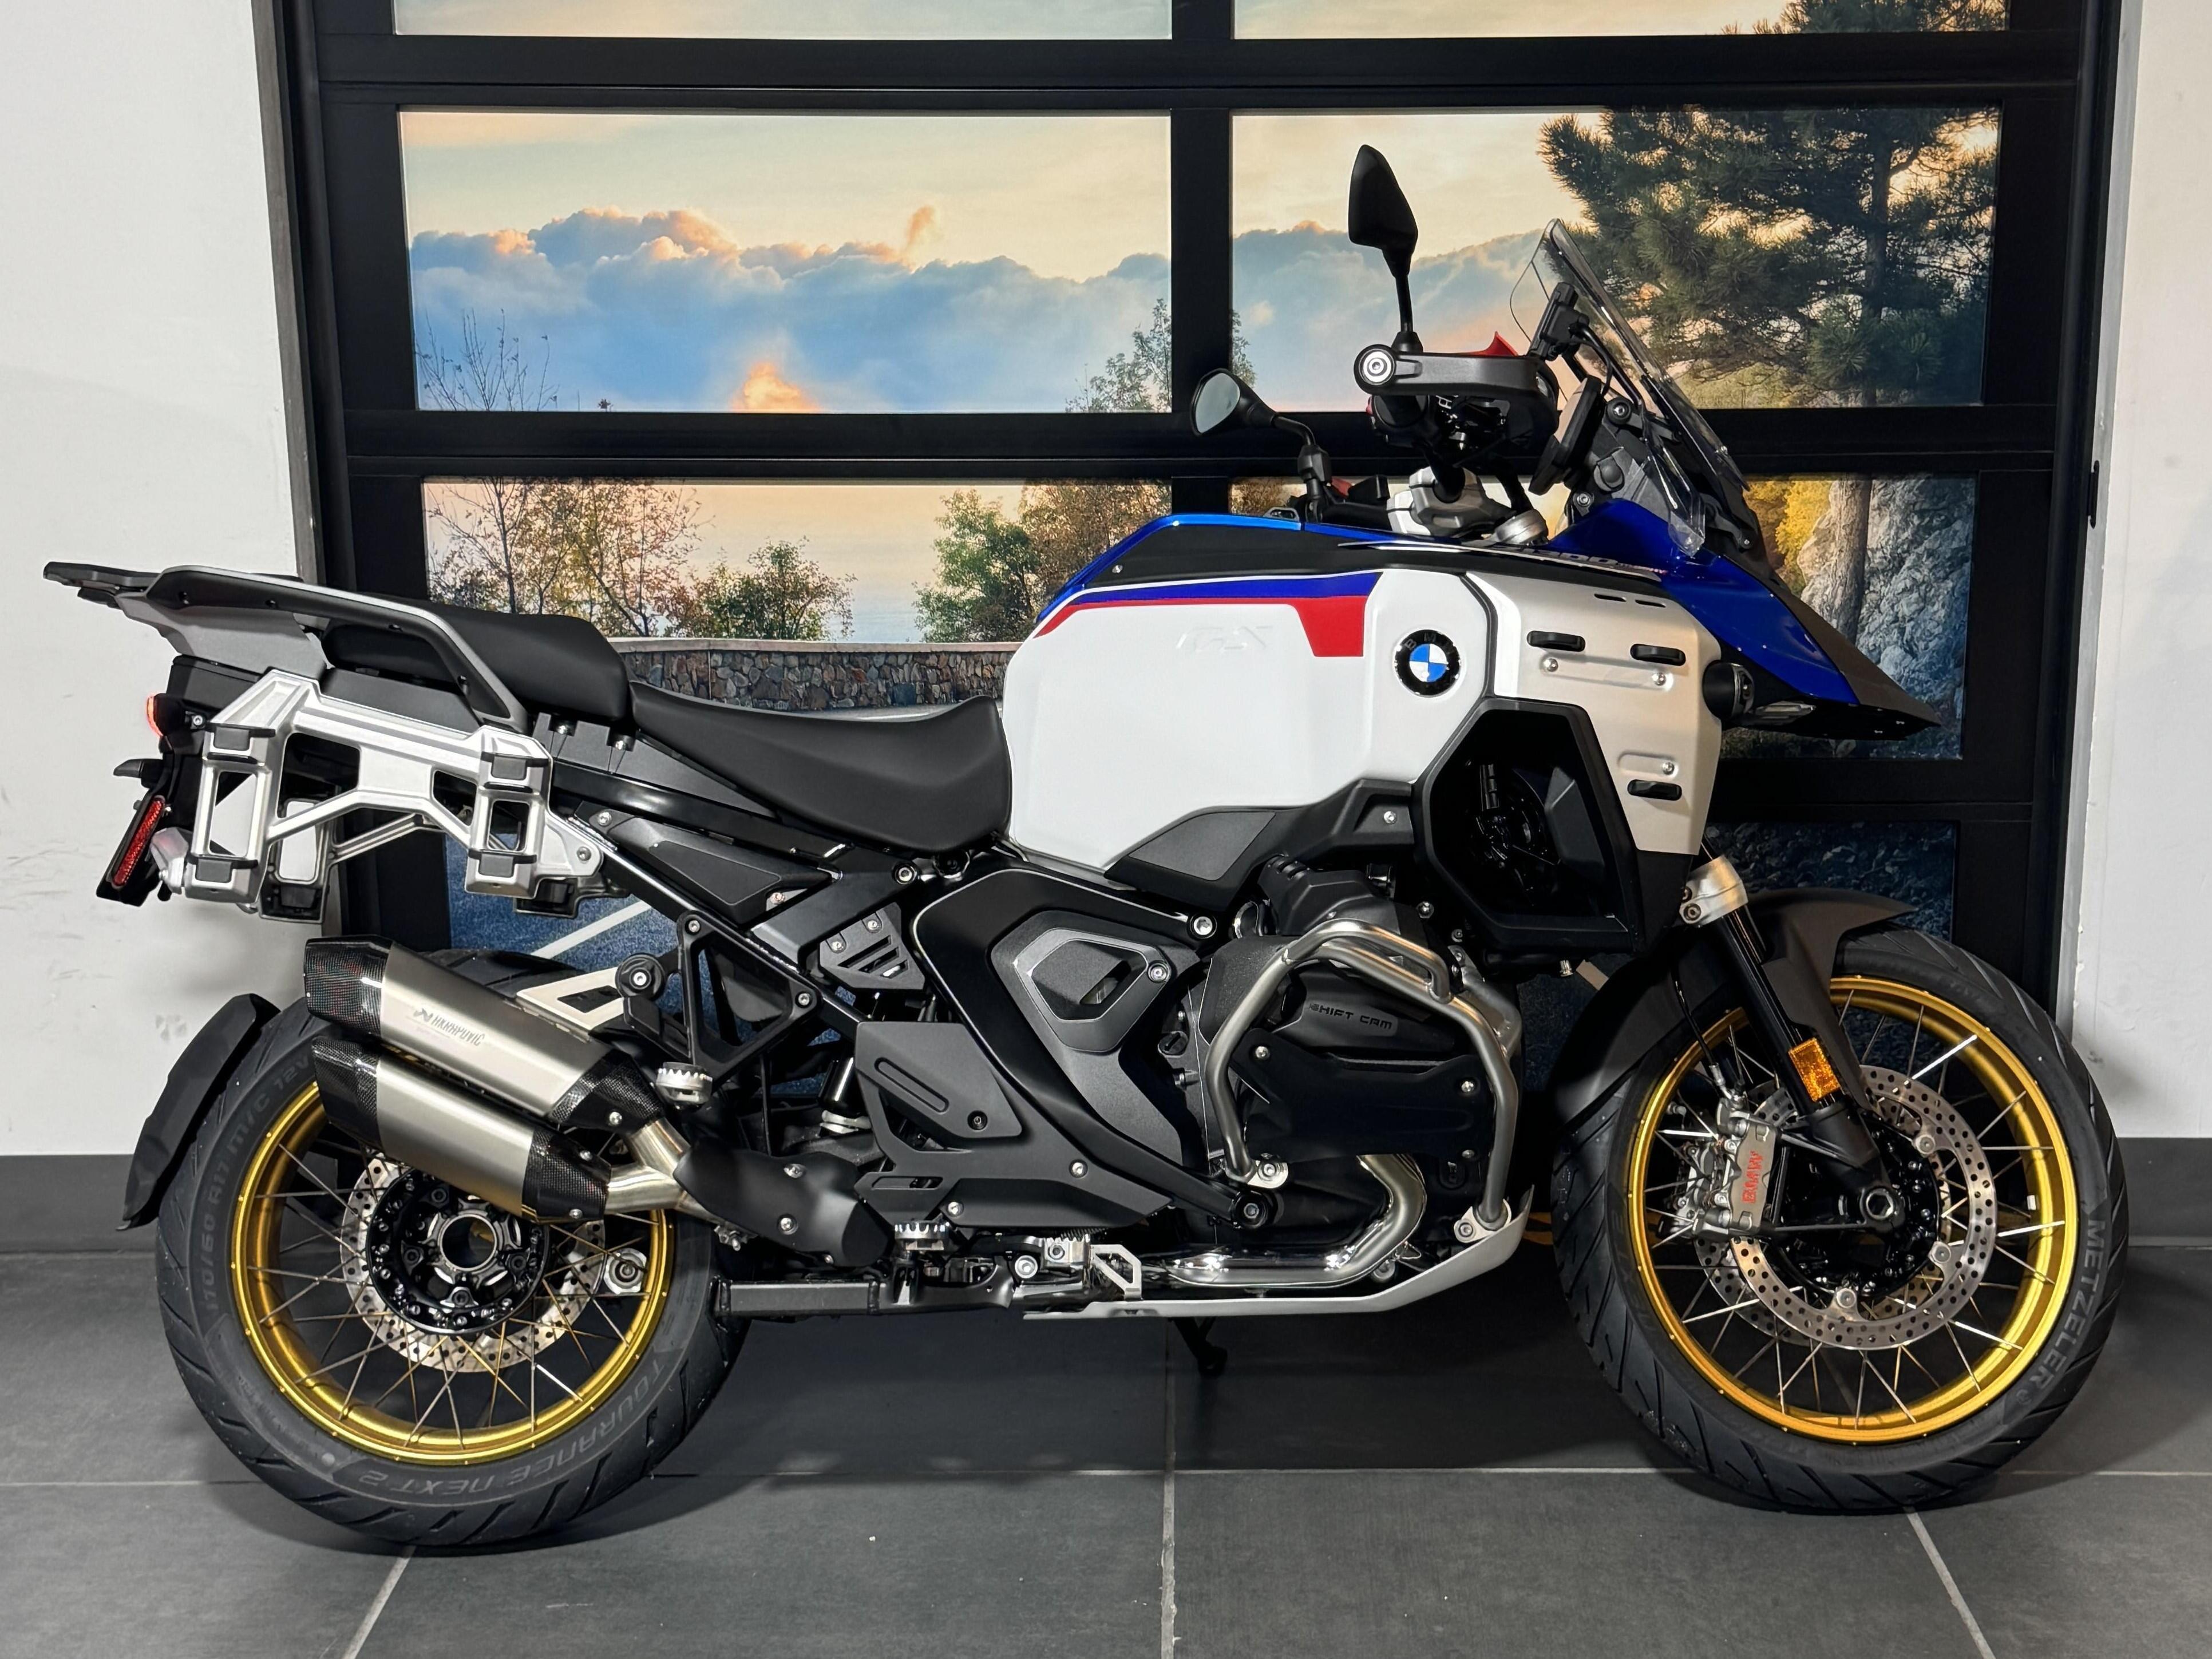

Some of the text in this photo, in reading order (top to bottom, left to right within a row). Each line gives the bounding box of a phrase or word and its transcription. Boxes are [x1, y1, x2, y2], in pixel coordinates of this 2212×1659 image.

[1309, 1003, 1392, 1030] SHIFT CAM
[2029, 1218, 2107, 1391] METZELER
[358, 1359, 665, 1496] TOURANCE NEXT 2
